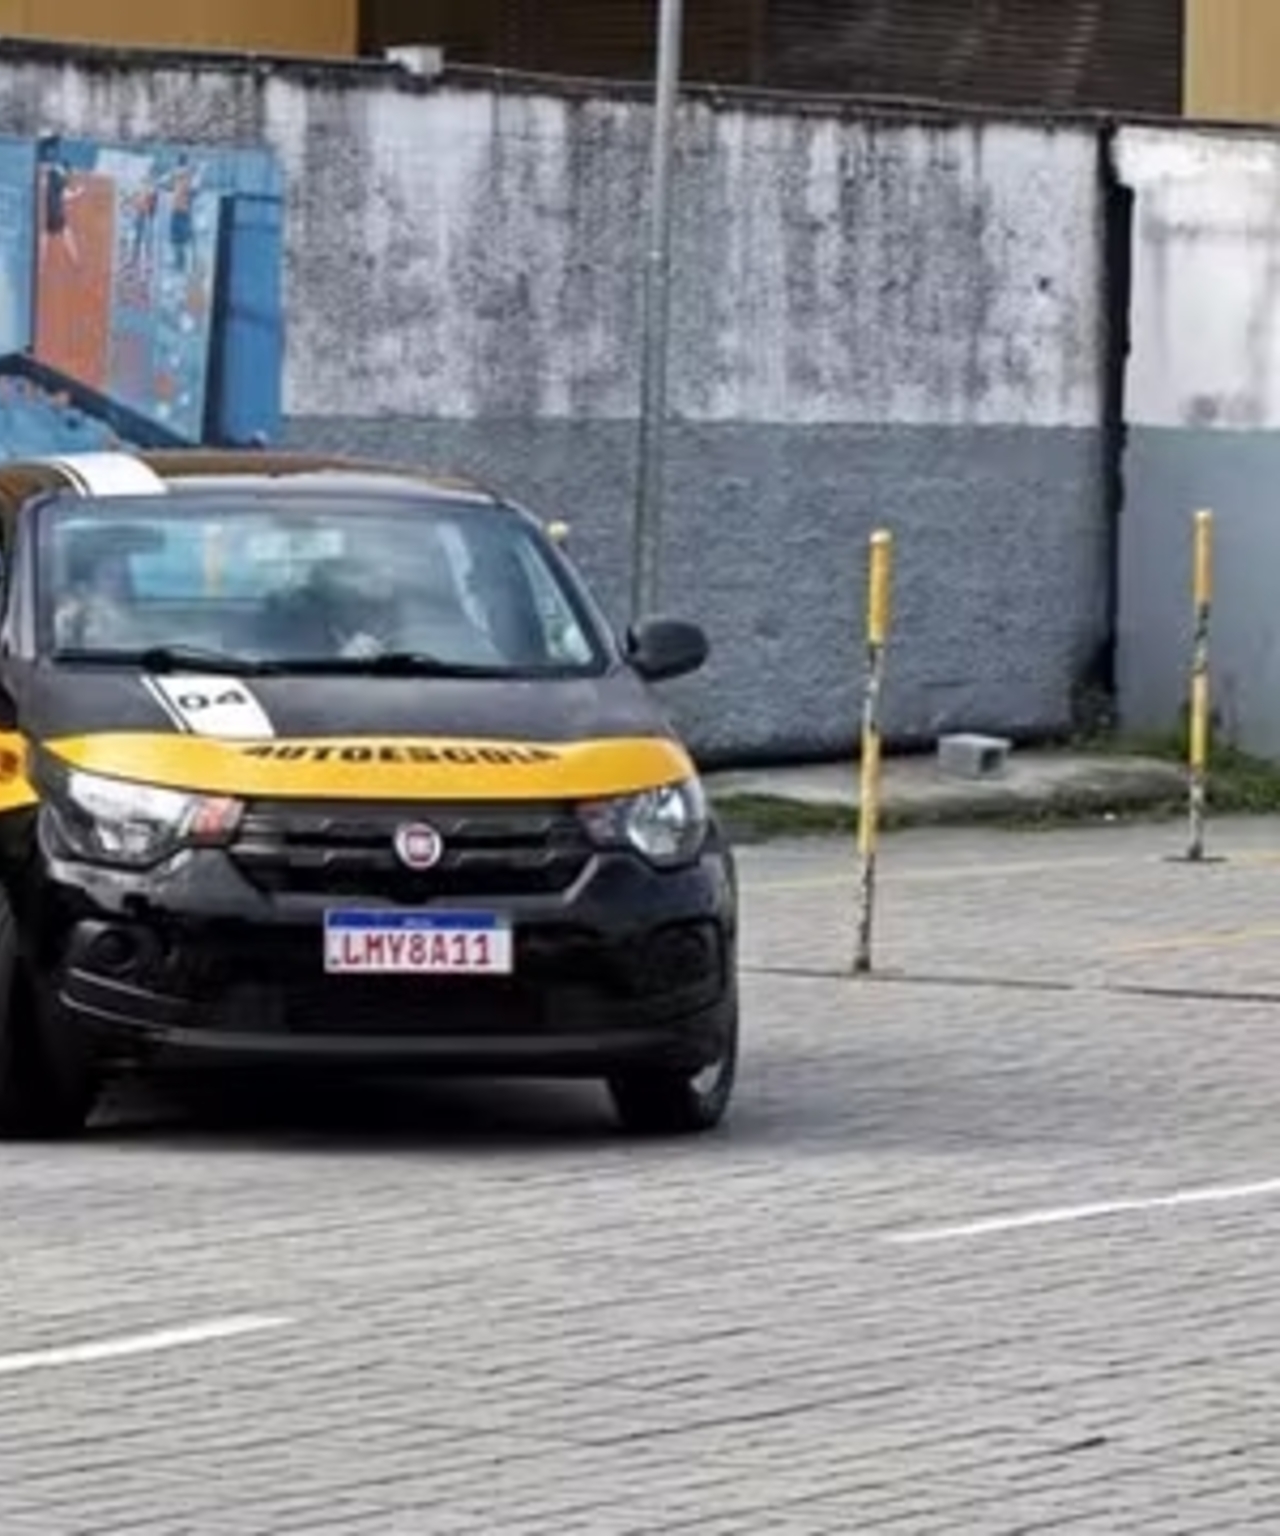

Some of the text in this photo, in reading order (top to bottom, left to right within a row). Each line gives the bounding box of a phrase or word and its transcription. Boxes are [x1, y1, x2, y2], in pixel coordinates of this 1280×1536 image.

[178, 689, 246, 711] 04
[241, 744, 563, 765] AUTOESCOLA
[342, 932, 491, 966] LMY8A11
